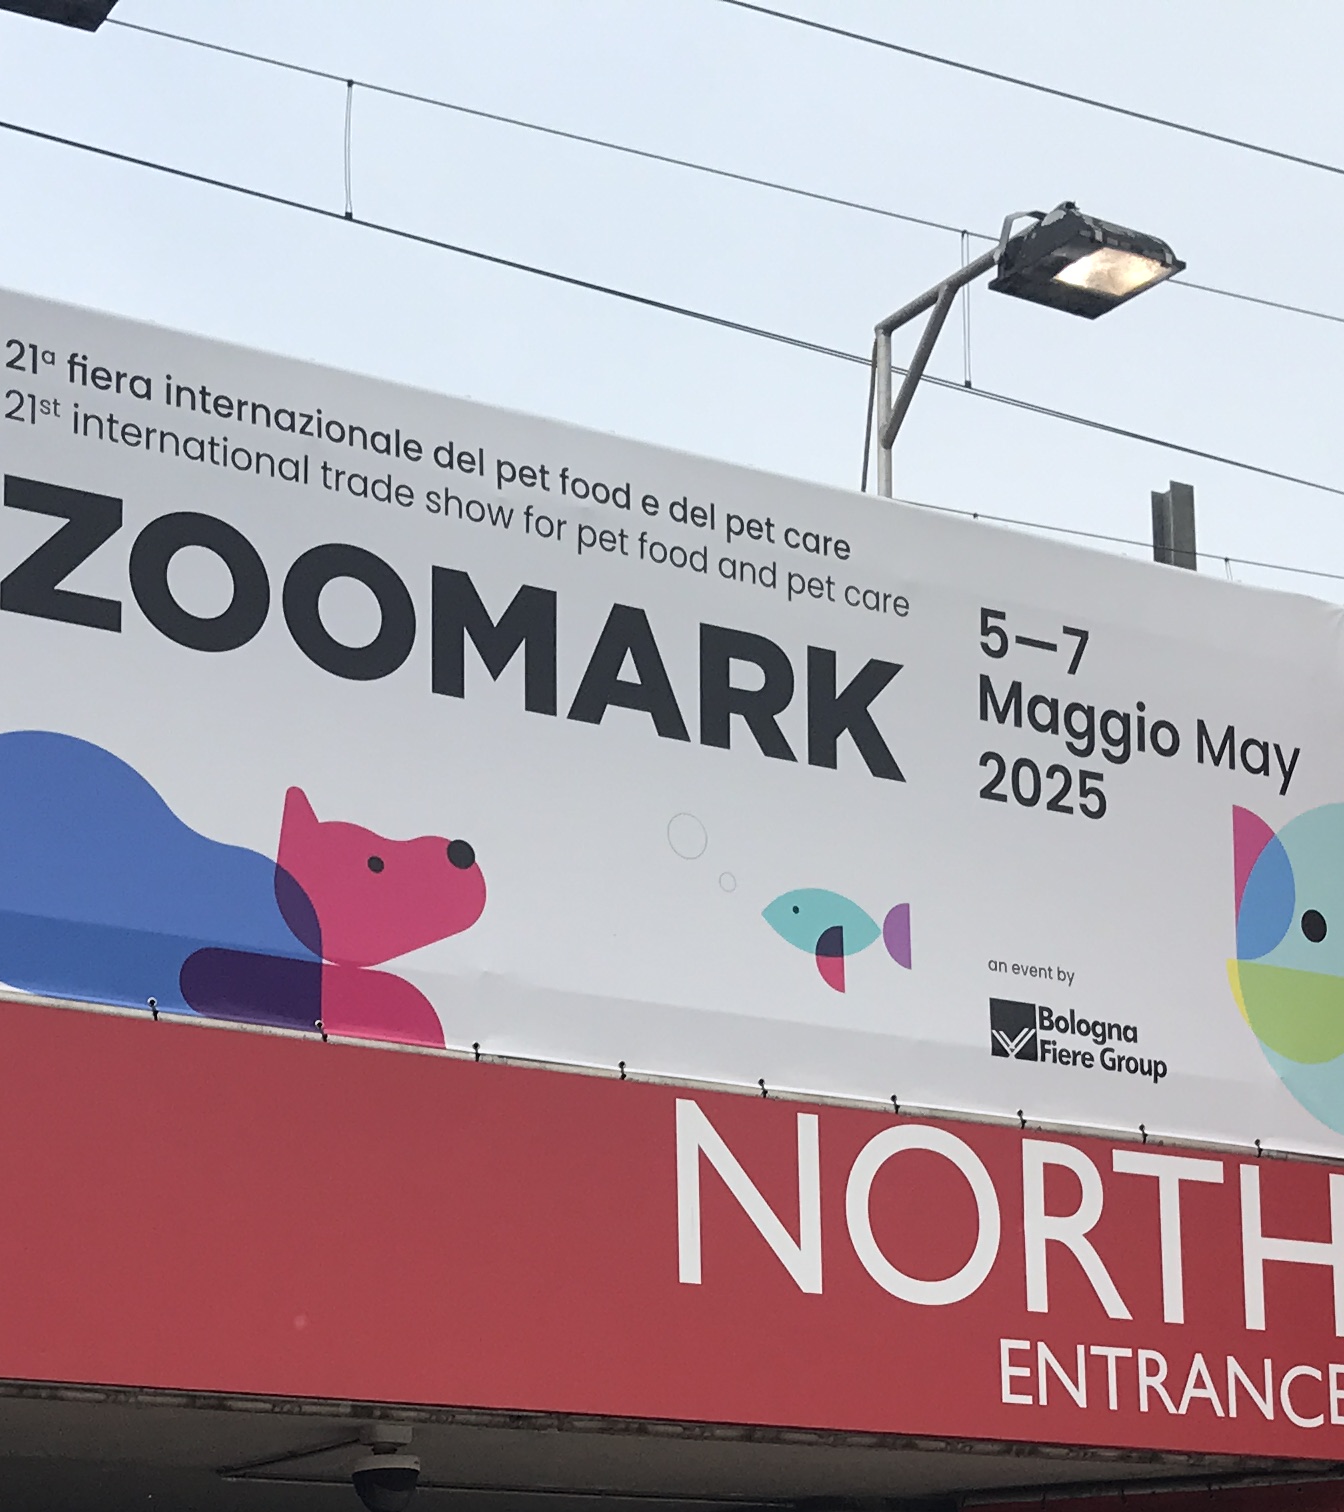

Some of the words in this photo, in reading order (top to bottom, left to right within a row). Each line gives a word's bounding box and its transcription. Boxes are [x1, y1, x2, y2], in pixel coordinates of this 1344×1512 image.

[5, 389, 61, 425] 21st
[72, 404, 310, 484] international
[320, 459, 416, 508] trade
[425, 487, 515, 530] show
[523, 505, 567, 541] for
[577, 522, 629, 556] pet
[639, 532, 709, 574] food
[718, 555, 778, 589] and
[787, 569, 836, 602] pet
[844, 582, 911, 617] care
[67, 352, 153, 401] fiera
[165, 374, 423, 462] internazionale
[433, 440, 485, 477] del
[497, 456, 550, 492] pet
[559, 467, 631, 511] food
[641, 493, 661, 516] e
[669, 497, 716, 531] del
[726, 513, 776, 545] pet
[783, 524, 851, 560] care
[0, 473, 906, 782] ZOOMARK
[979, 673, 1180, 765] Maggio
[1197, 718, 1301, 796] May
[979, 750, 1107, 820] 2025
[988, 959, 1007, 973] an
[1012, 963, 1053, 980] event
[1057, 966, 1075, 987] by
[1038, 1005, 1138, 1046] Bologna
[1040, 1039, 1095, 1069] Fiere
[1100, 1047, 1168, 1084] Group
